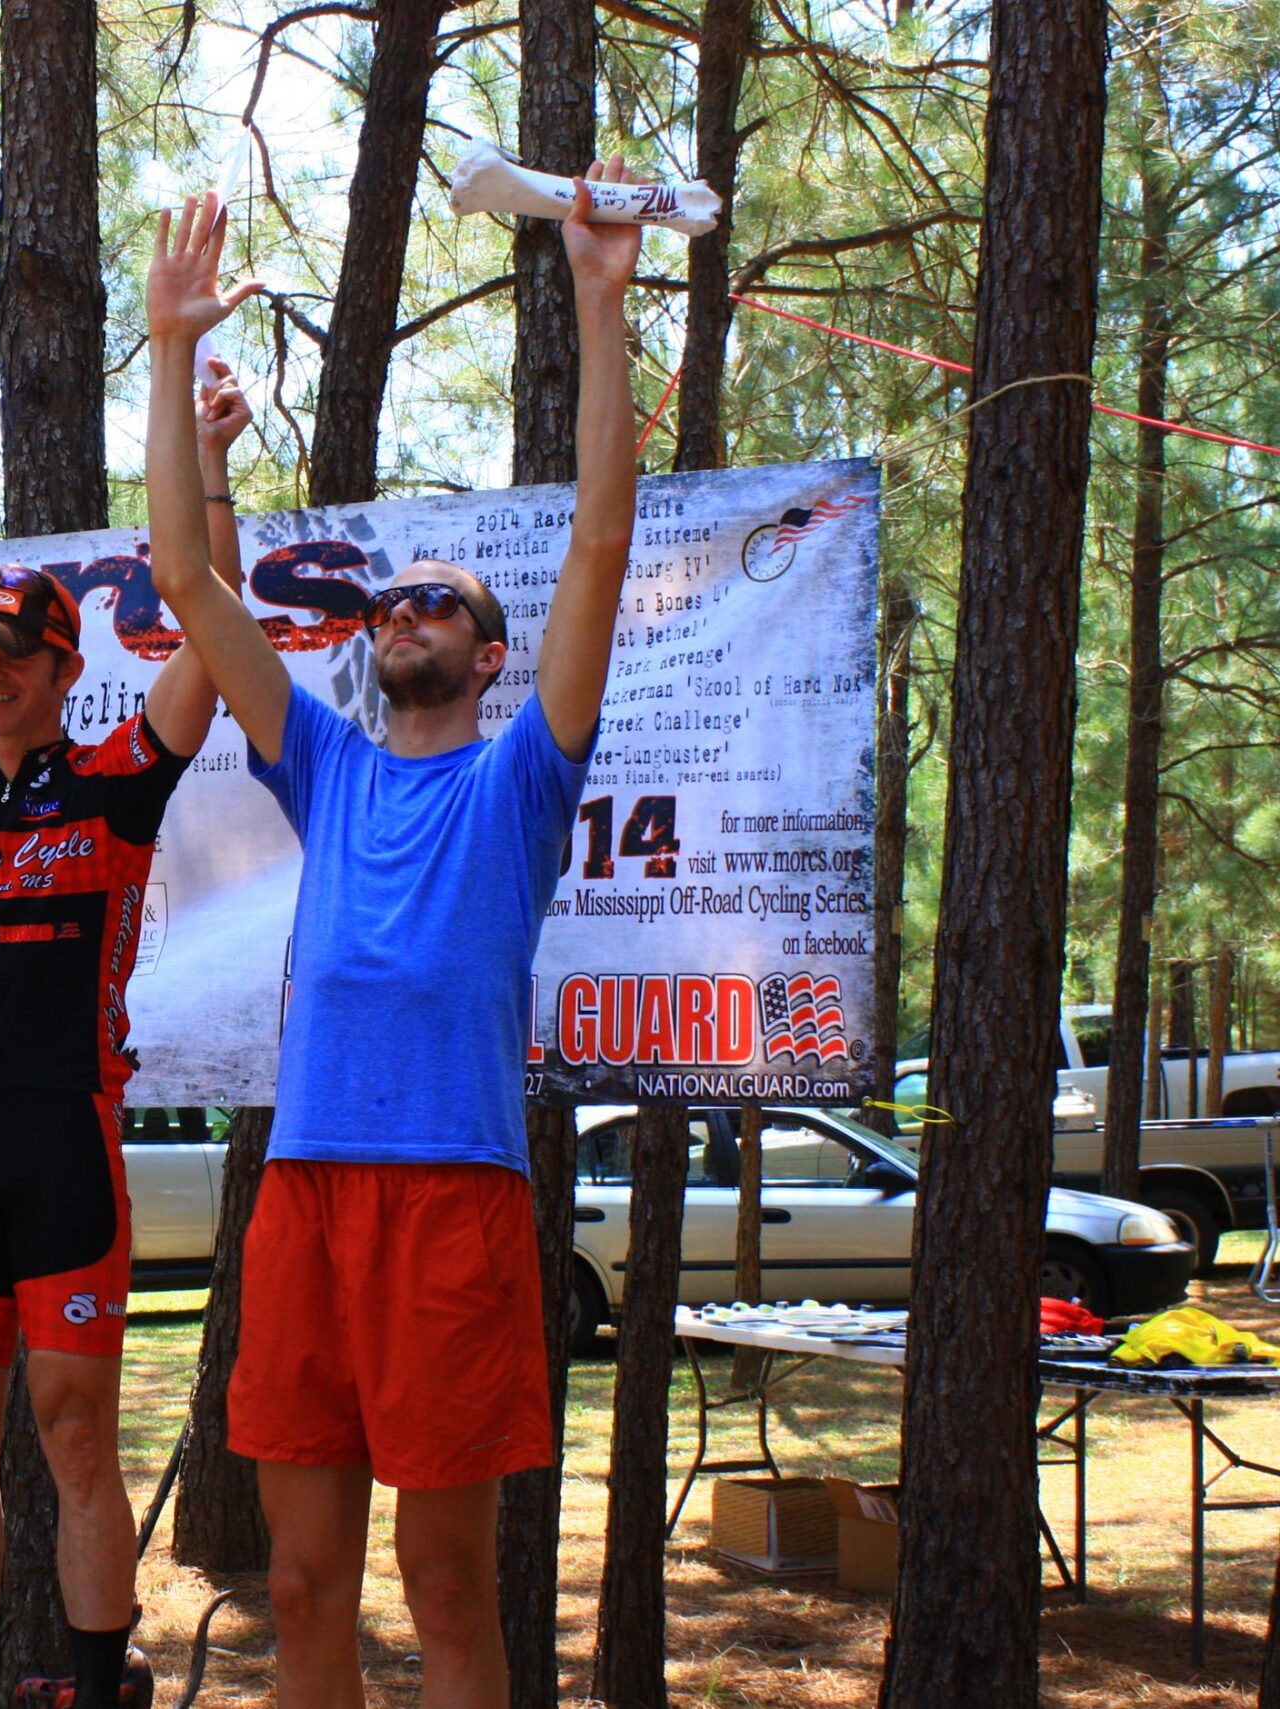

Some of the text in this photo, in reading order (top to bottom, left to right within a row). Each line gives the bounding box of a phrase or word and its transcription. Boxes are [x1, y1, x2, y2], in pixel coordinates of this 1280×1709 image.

[476, 508, 521, 533] 2014
[638, 498, 685, 520] dule
[450, 537, 467, 562] 16
[476, 537, 549, 560] Meridian
[748, 533, 769, 557] USA
[655, 591, 702, 616] Bones
[617, 630, 635, 648] at
[615, 657, 651, 679] Park
[601, 681, 674, 707] Ackerman
[753, 675, 772, 696] of
[783, 675, 822, 695] Hard
[598, 713, 644, 736] Creek
[193, 751, 238, 774] stuff!
[594, 740, 729, 769] ee-Lungbuster'
[677, 768, 730, 787] year-end
[720, 809, 740, 834] for
[744, 815, 779, 833] more
[13, 829, 95, 871] Cycle
[688, 849, 863, 881] visit www.morcs.org
[19, 872, 55, 889] MS
[575, 886, 665, 924] Mississippi
[670, 885, 744, 915] Off-Road
[748, 884, 812, 922] Cycling
[815, 884, 868, 915] Series
[111, 882, 142, 975] Indian
[782, 930, 869, 955] on facebook
[558, 972, 758, 1067] GUARD
[637, 1073, 850, 1099] NATIONALGUARD.com
